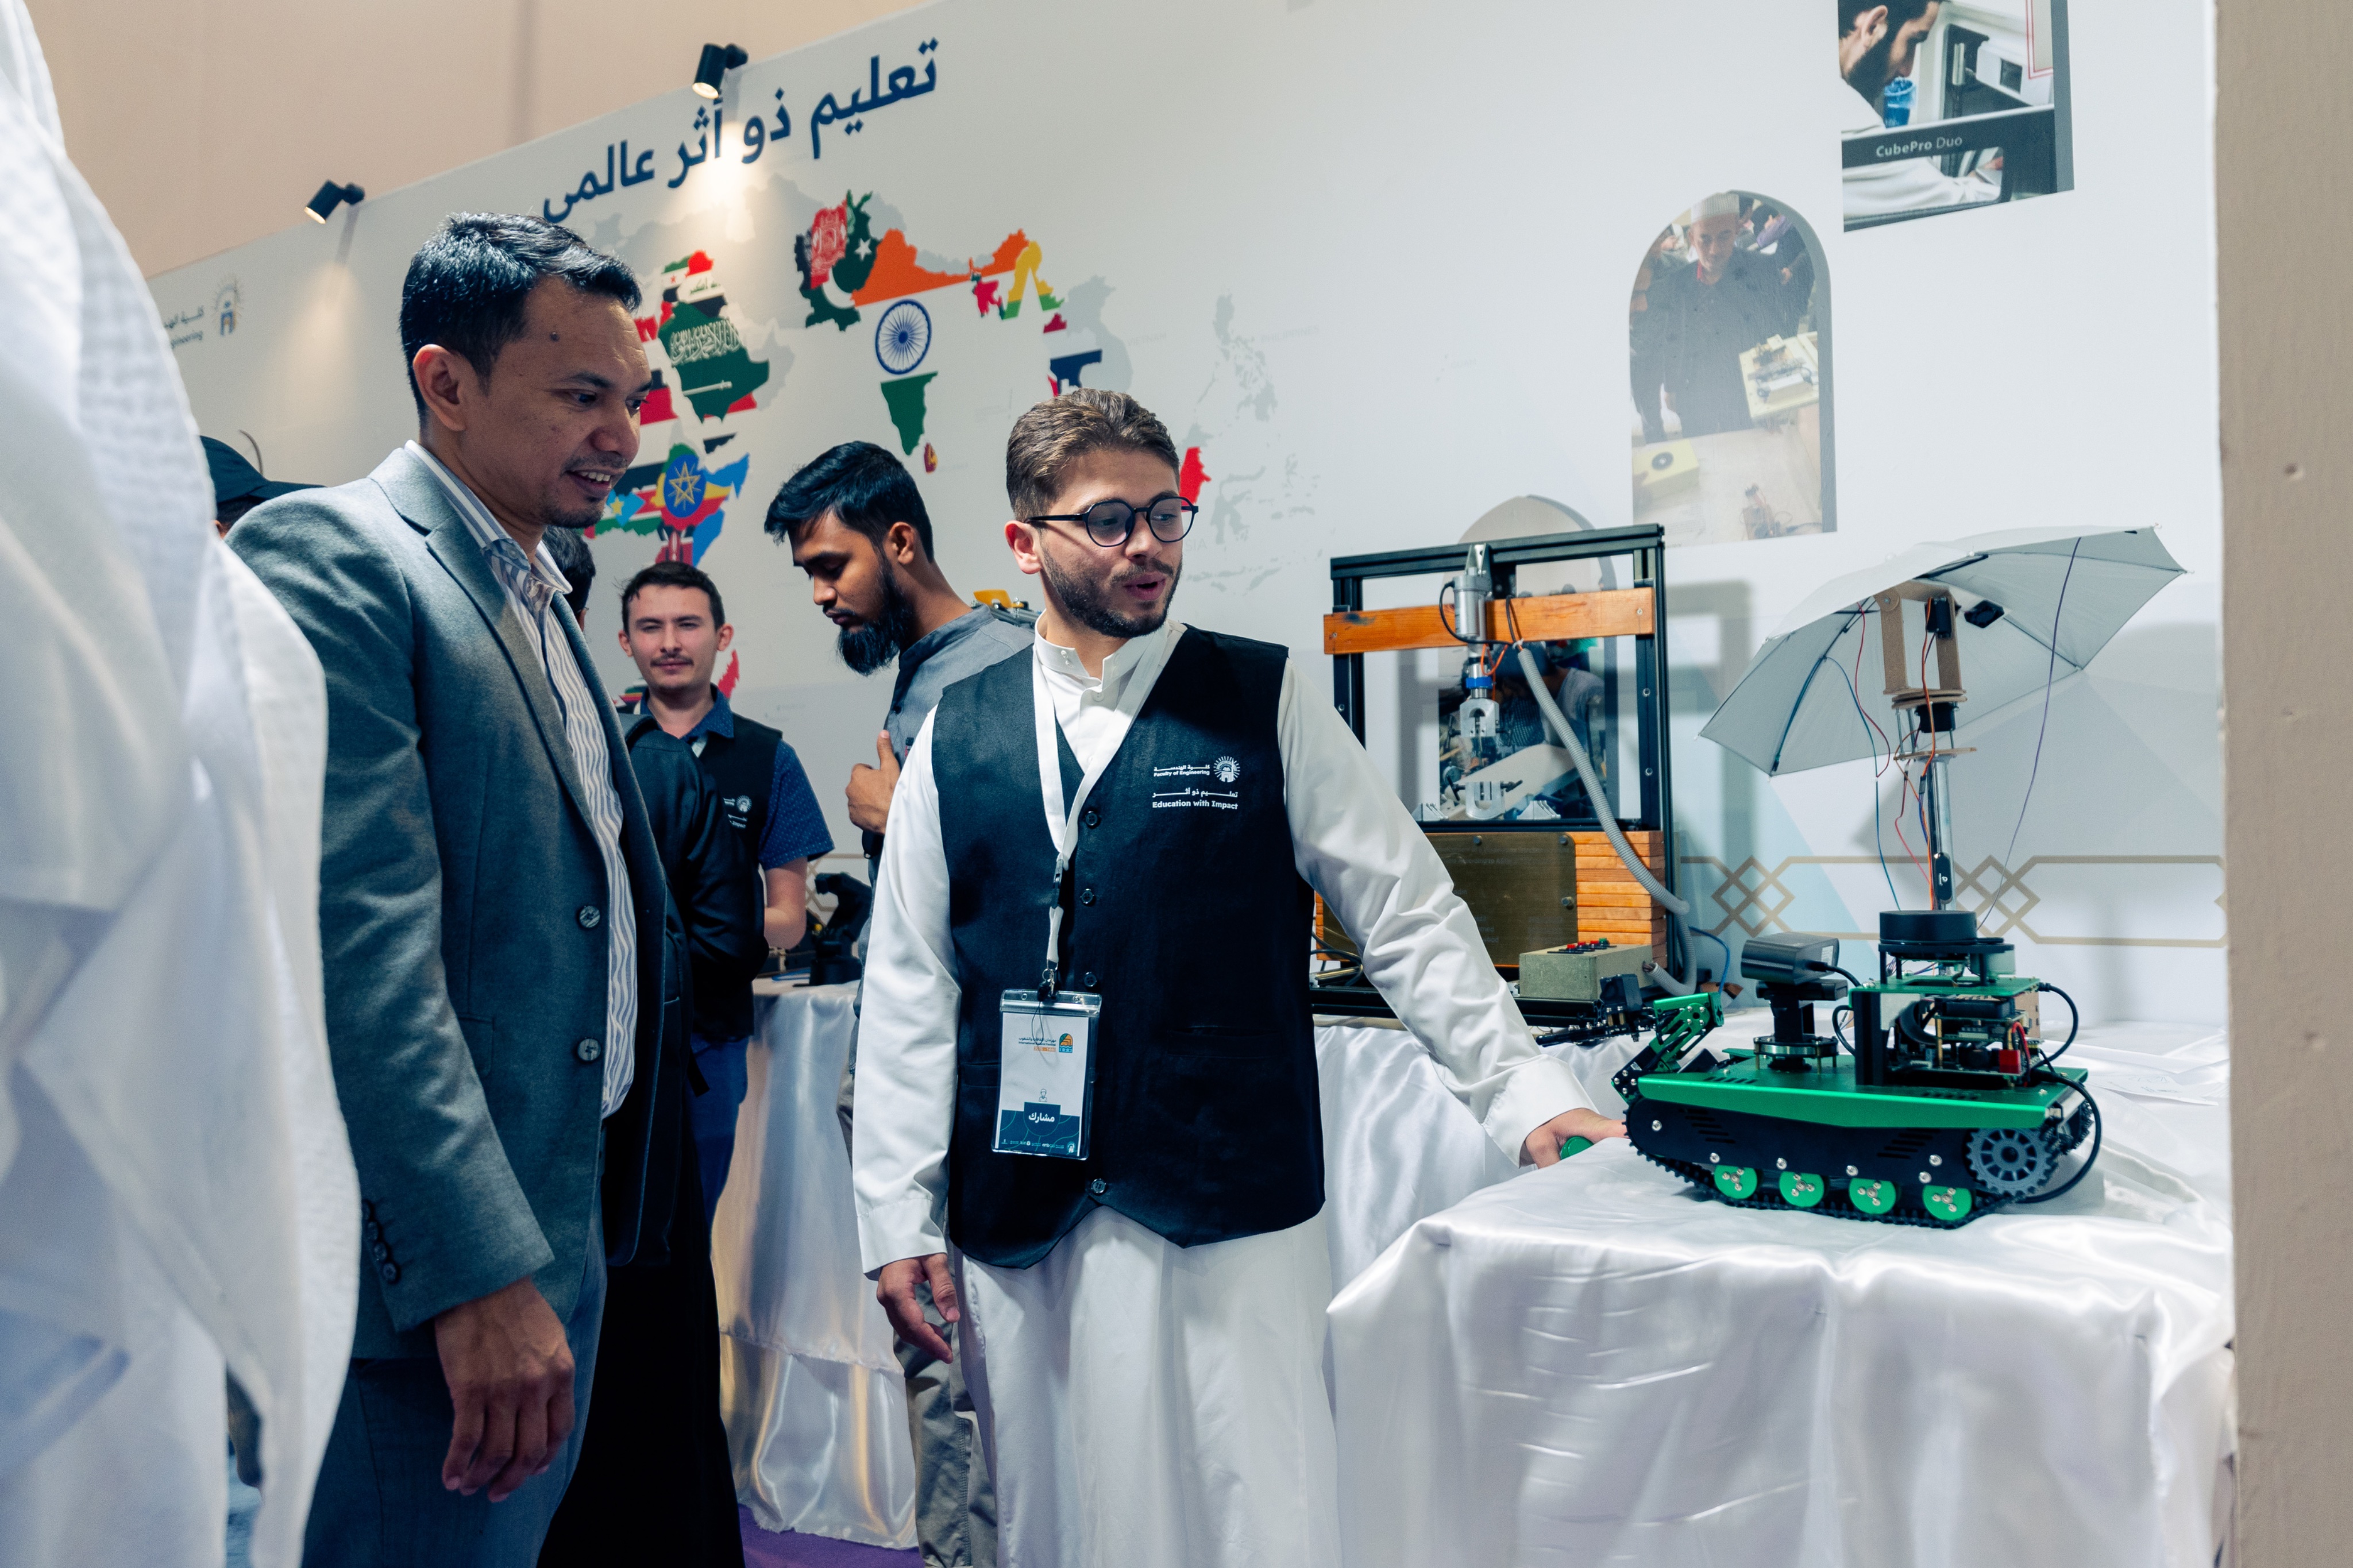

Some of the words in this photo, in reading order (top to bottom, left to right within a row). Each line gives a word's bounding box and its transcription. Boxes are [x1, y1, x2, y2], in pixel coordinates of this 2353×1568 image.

[811, 37, 938, 159] تعليم
[742, 87, 792, 164] ذو
[667, 87, 724, 188] أثر
[1876, 140, 1932, 157] CubePro
[1936, 137, 1962, 149] Duo
[1127, 331, 1167, 346] VIETNAM
[1260, 325, 1320, 343] PHILIPPINES
[1152, 800, 1191, 808] Education
[1212, 800, 1238, 810] Impact
[1028, 1112, 1055, 1123] مشارك
